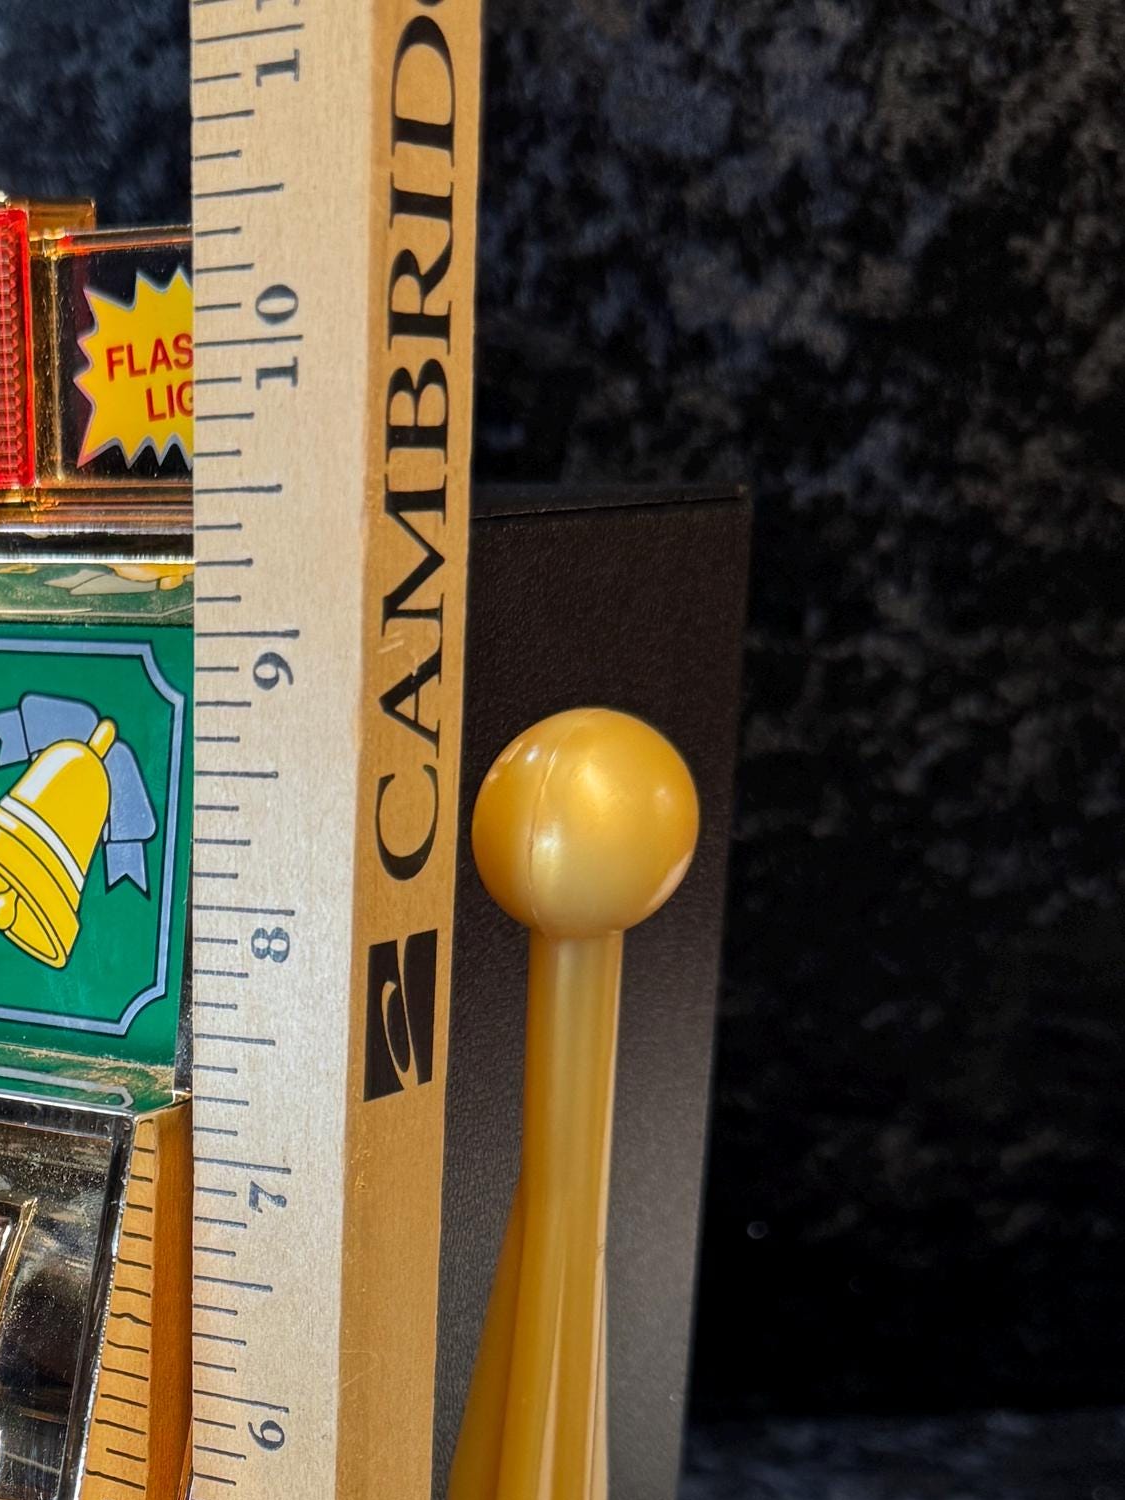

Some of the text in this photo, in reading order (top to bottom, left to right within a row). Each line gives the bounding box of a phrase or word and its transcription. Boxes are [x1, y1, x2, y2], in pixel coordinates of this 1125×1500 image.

[254, 283, 299, 390] 10
[375, 0, 457, 881] CAMBRID
[251, 651, 295, 691] 9
[250, 927, 291, 964] 8
[247, 1180, 288, 1214] 7
[247, 1420, 286, 1452] 6
